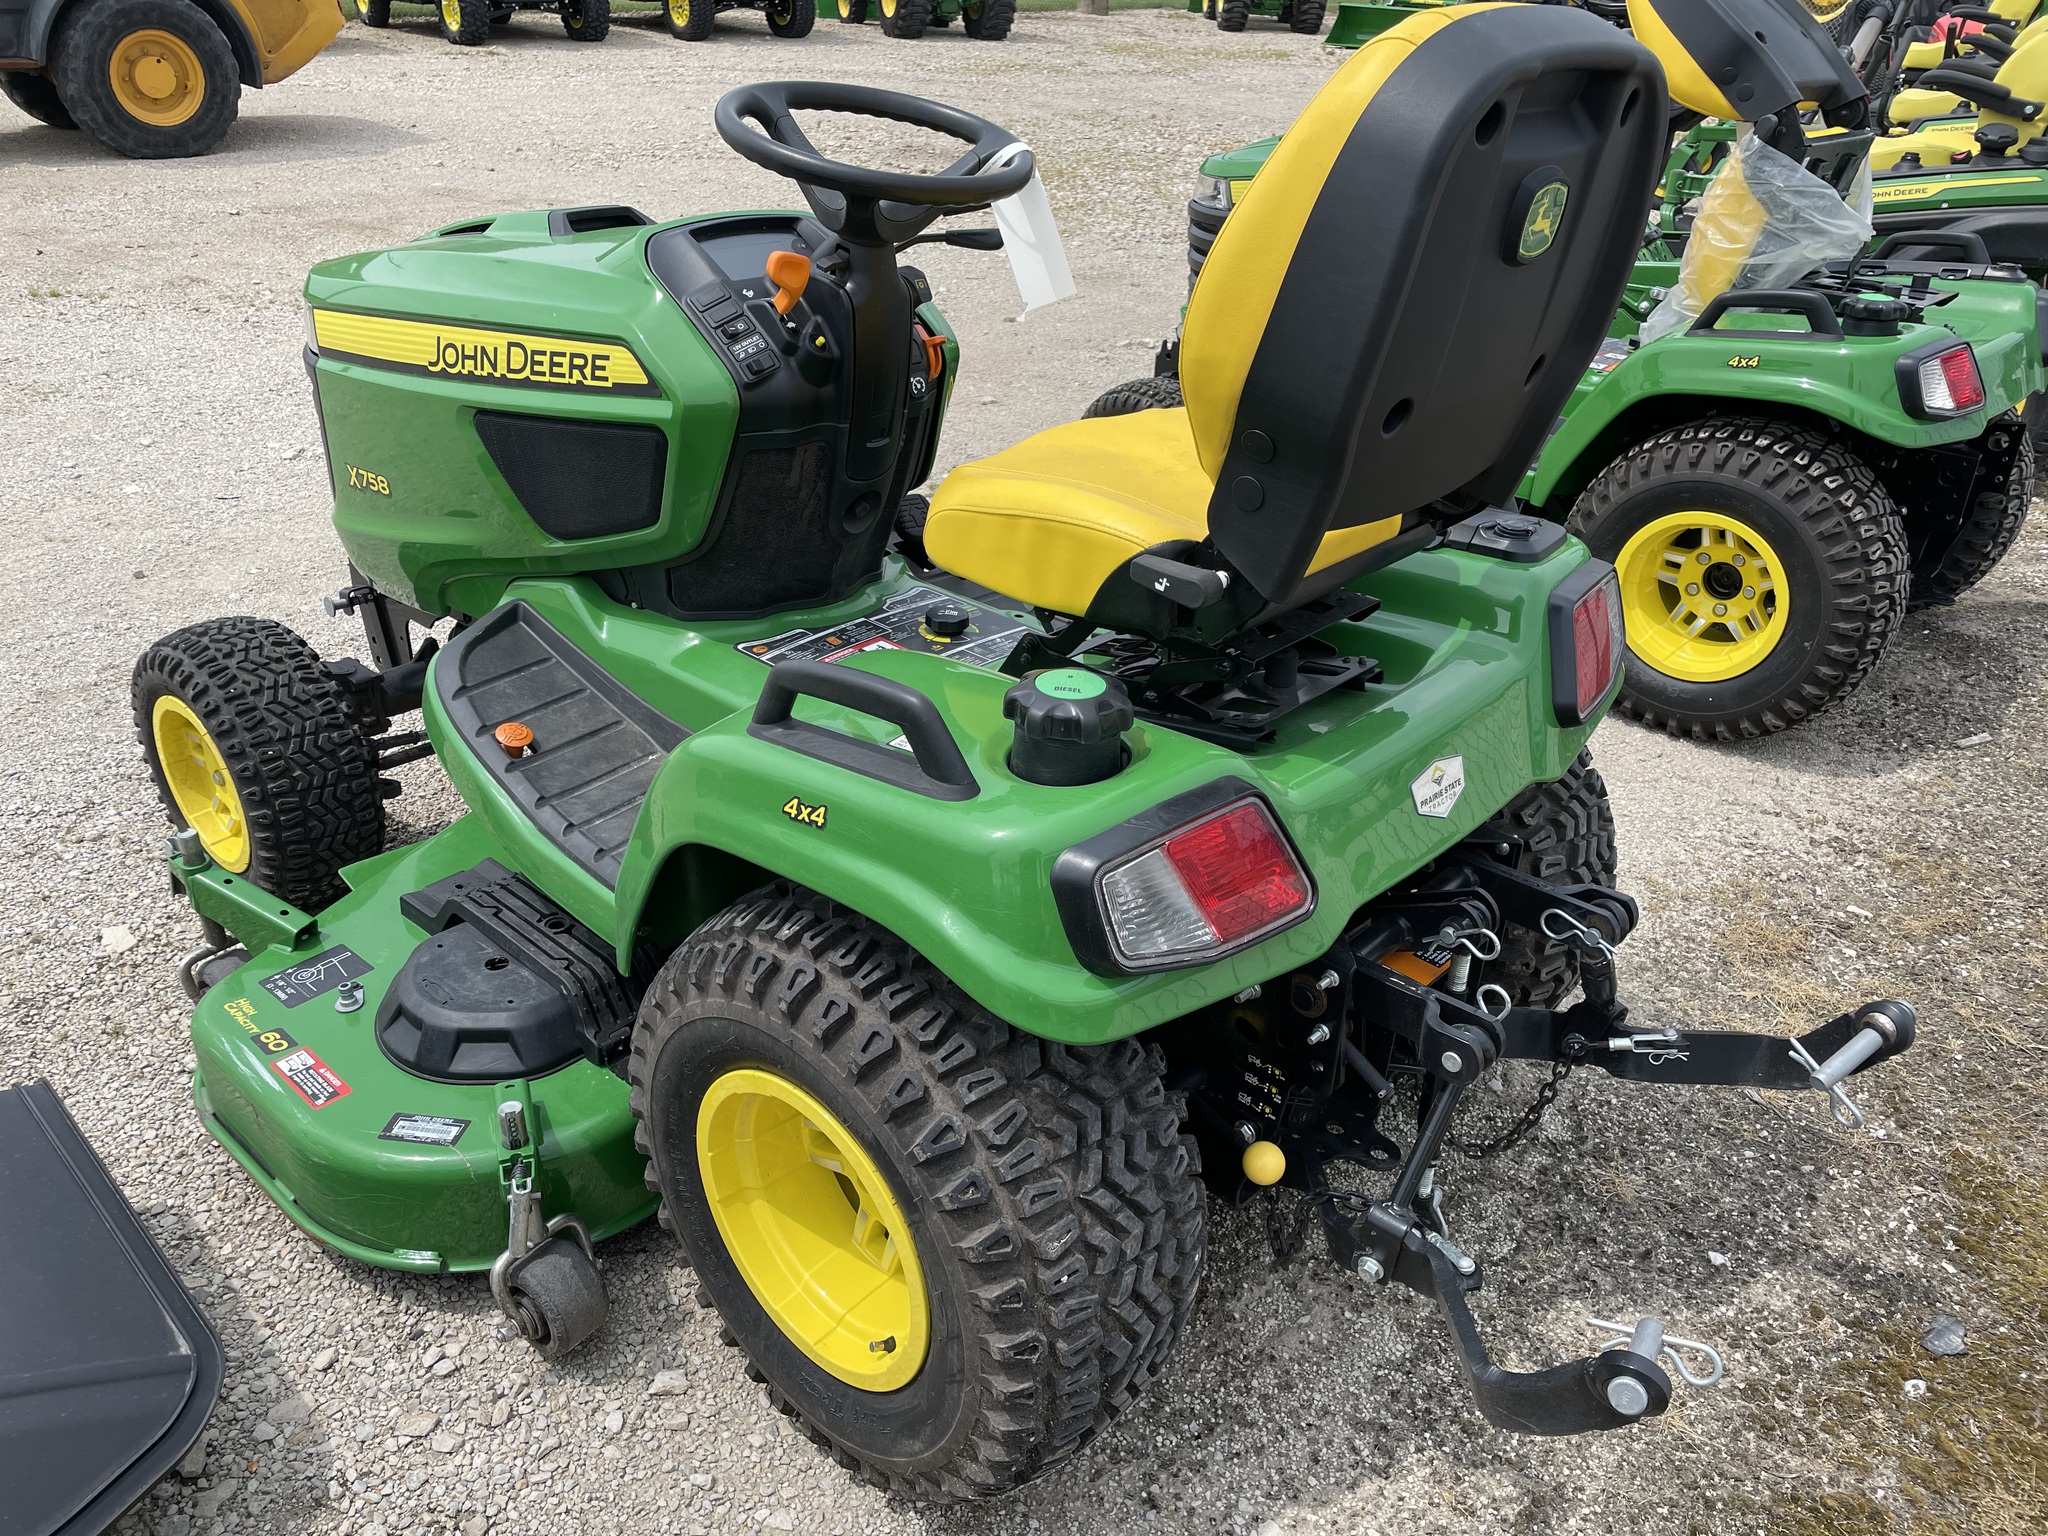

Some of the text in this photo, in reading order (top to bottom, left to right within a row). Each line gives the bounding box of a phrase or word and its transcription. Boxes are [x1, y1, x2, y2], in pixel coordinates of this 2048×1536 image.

[1872, 187, 1928, 199] OHN DEERE
[741, 334, 760, 347] OUTLET
[428, 335, 612, 386] JOHN DEERE
[1727, 354, 1760, 368] 4x4
[345, 463, 391, 497] X758
[1054, 686, 1082, 694] DIESEL
[1420, 777, 1462, 809] PRAIRIE STATE
[1428, 790, 1458, 813] TRACTOR
[782, 796, 827, 828] 4x4
[234, 997, 258, 1016] HIGH
[223, 1002, 261, 1034] CAPACITY
[260, 1031, 289, 1052] 60
[323, 1069, 342, 1088] DANGER
[431, 1116, 454, 1124] DEERE
